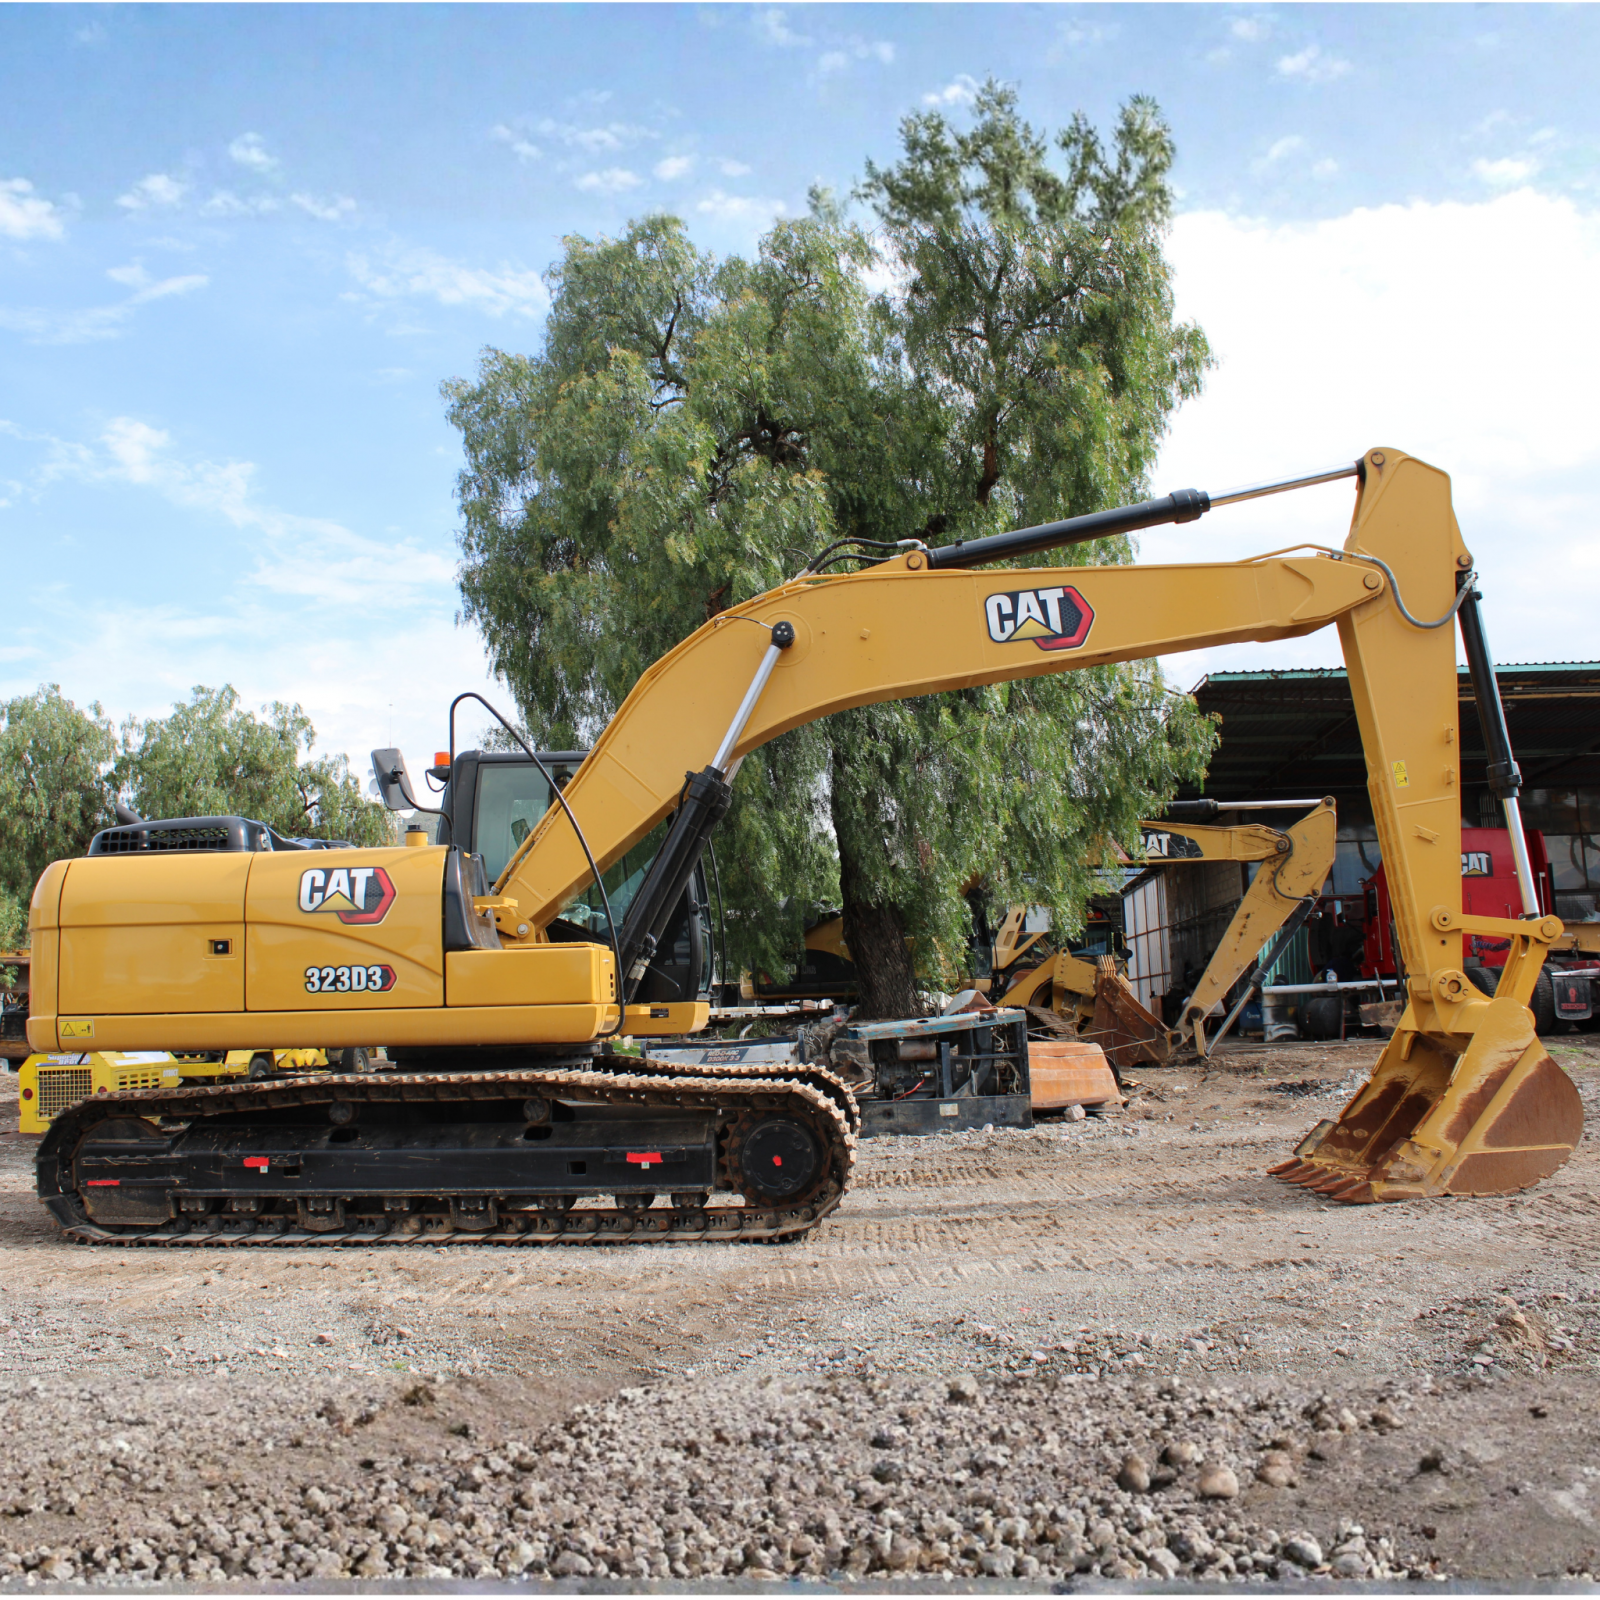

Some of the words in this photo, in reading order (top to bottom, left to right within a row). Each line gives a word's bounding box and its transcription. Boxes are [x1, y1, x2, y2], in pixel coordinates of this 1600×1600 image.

[986, 587, 1064, 642] CAT
[300, 868, 374, 912] CAT
[305, 965, 382, 992] 323D3
